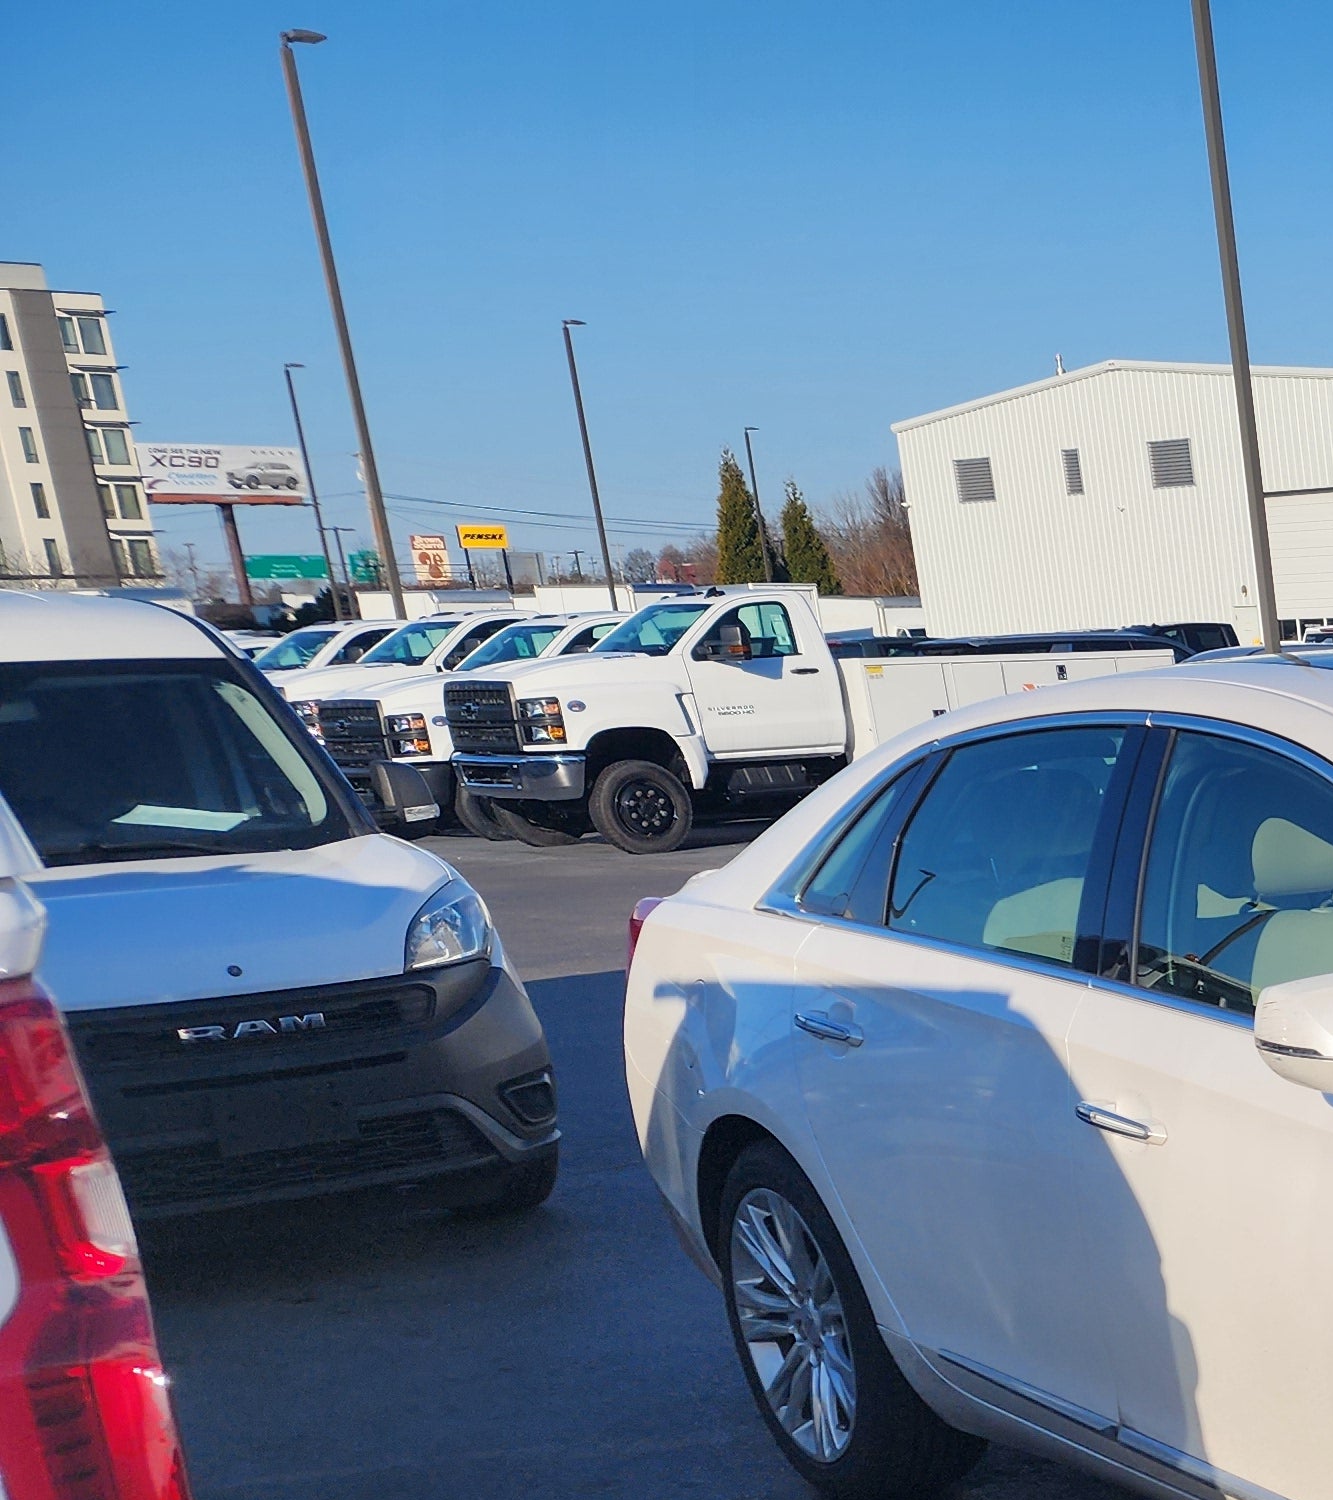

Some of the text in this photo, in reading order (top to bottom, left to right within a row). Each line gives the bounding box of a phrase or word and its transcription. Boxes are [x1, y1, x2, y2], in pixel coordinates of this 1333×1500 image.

[149, 454, 220, 469] XC90
[462, 533, 505, 541] PENSKE
[177, 1012, 327, 1042] RAM
